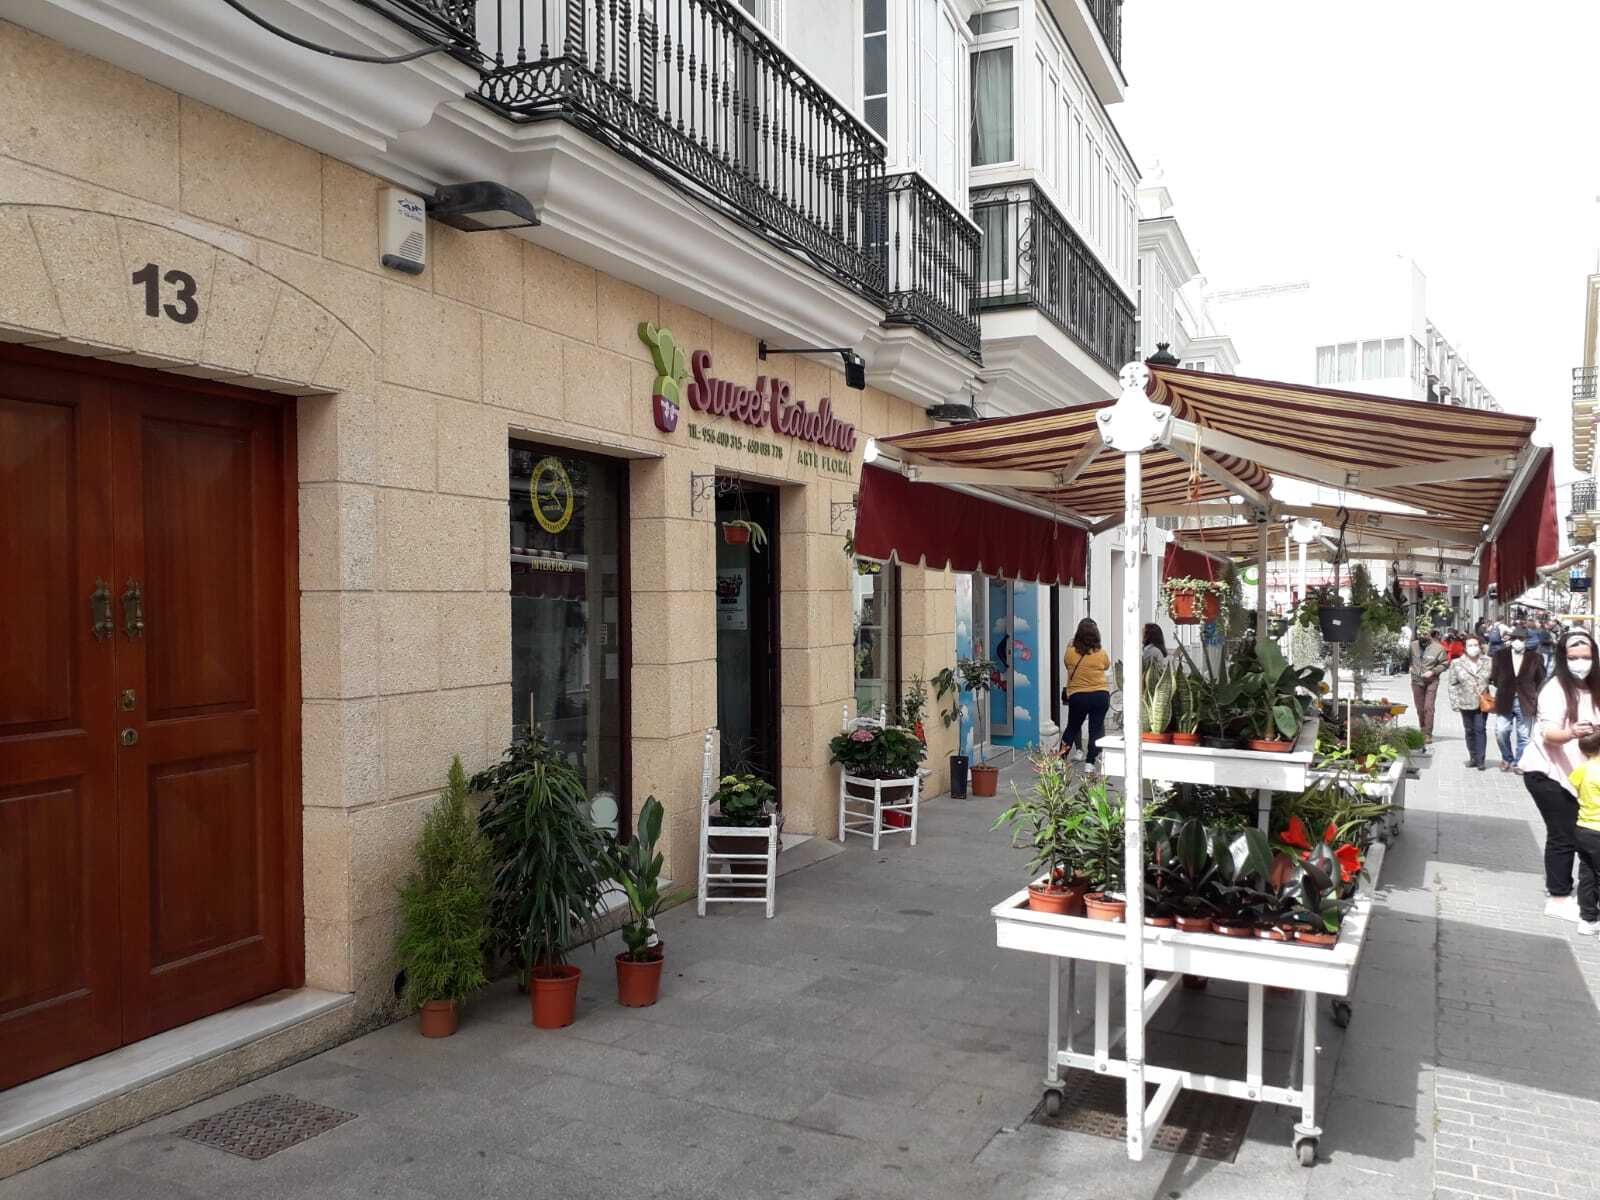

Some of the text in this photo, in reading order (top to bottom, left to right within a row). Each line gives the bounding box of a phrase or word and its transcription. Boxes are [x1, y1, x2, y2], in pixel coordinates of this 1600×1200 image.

[132, 263, 198, 324] 13
[687, 350, 857, 452] Sweet Carolina
[702, 427, 715, 444] 956
[797, 449, 852, 475] ARTE FLORAL
